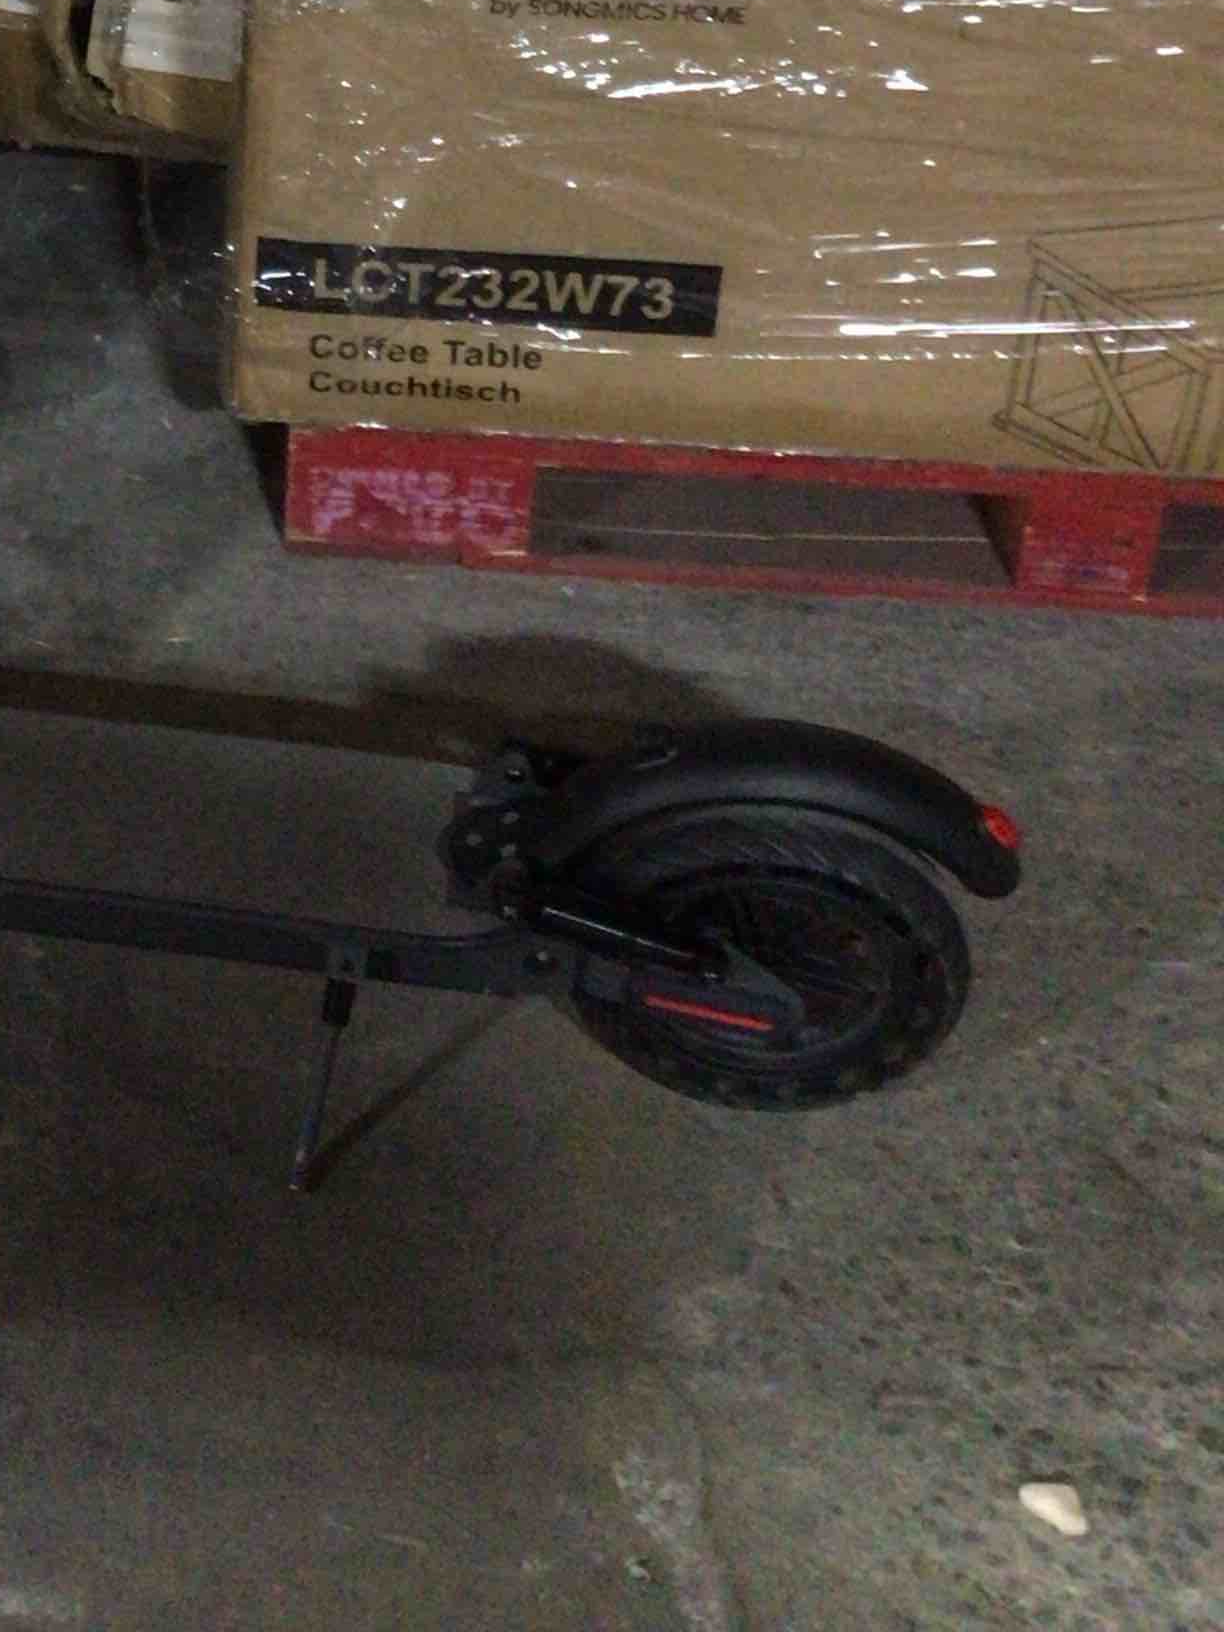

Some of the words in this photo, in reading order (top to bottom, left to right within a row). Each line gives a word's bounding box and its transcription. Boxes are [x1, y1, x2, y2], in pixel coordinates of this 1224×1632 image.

[675, 0, 746, 25] HOME
[313, 257, 674, 321] LCT232W73
[308, 332, 430, 366] Coffee
[442, 339, 544, 371] Table
[308, 369, 522, 405] Couchtisch
